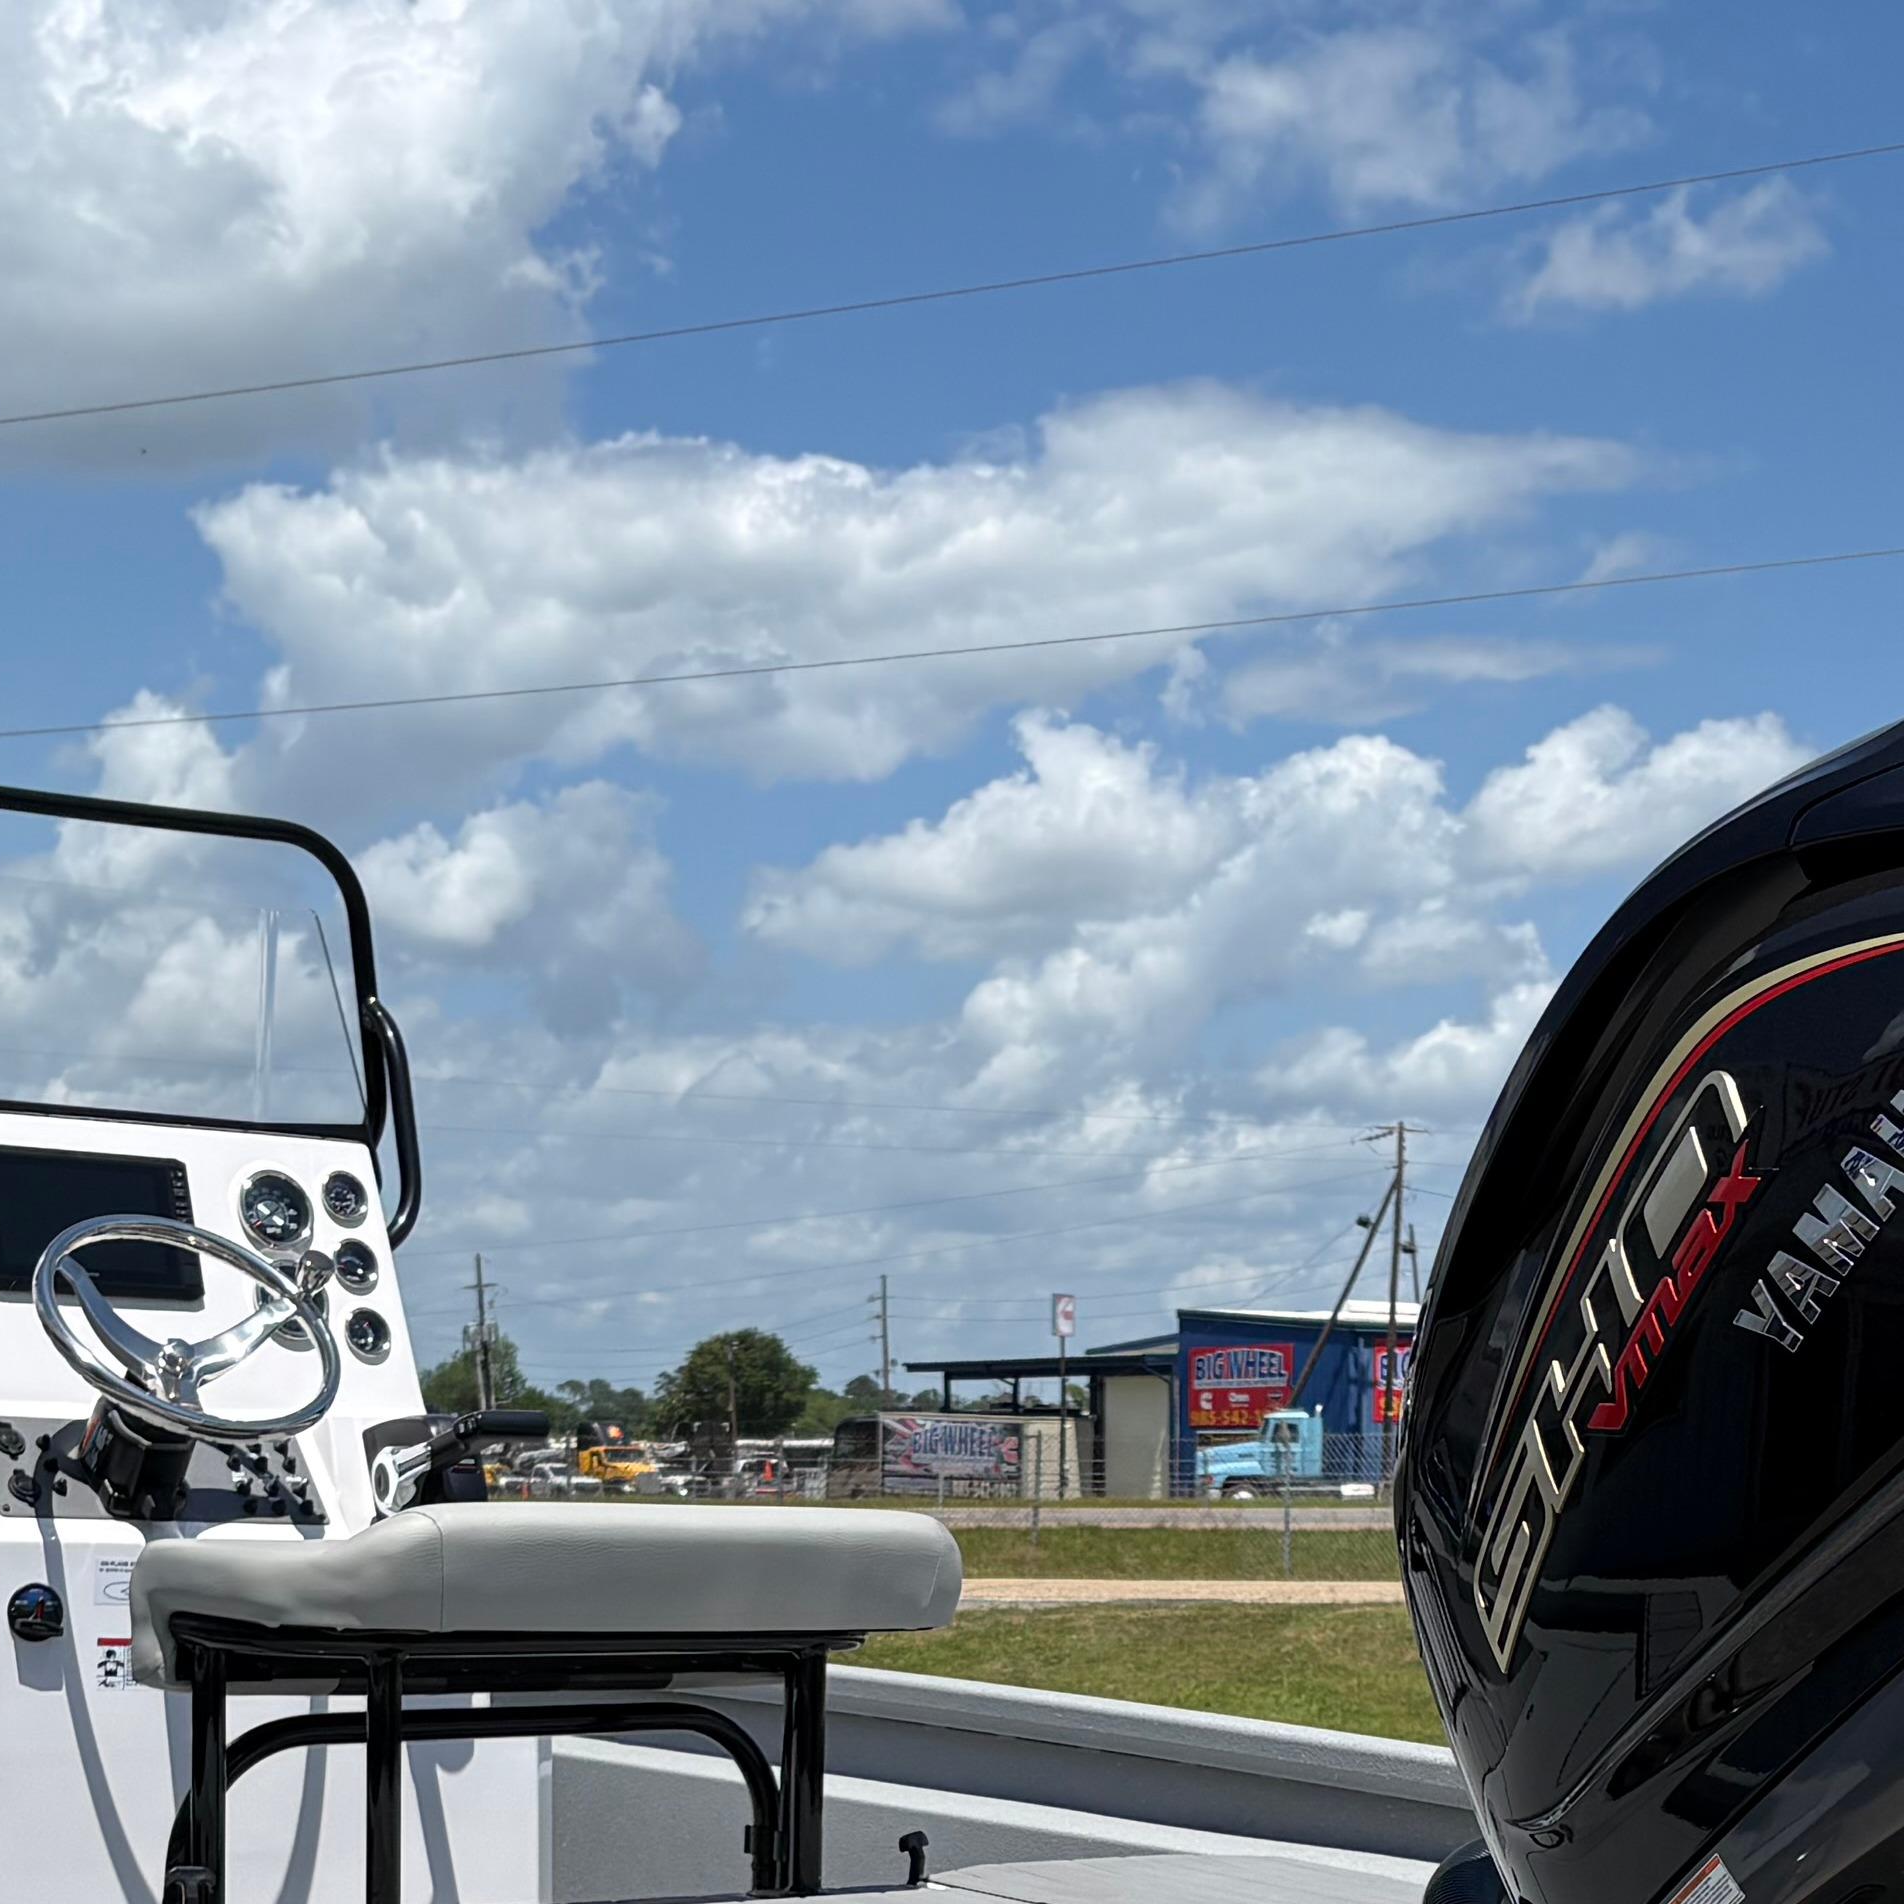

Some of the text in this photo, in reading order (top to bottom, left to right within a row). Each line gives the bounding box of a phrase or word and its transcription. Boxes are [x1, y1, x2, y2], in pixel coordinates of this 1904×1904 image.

[1196, 1349, 1288, 1381] BIG WHEEL
[1474, 1069, 1749, 1673] SHO
